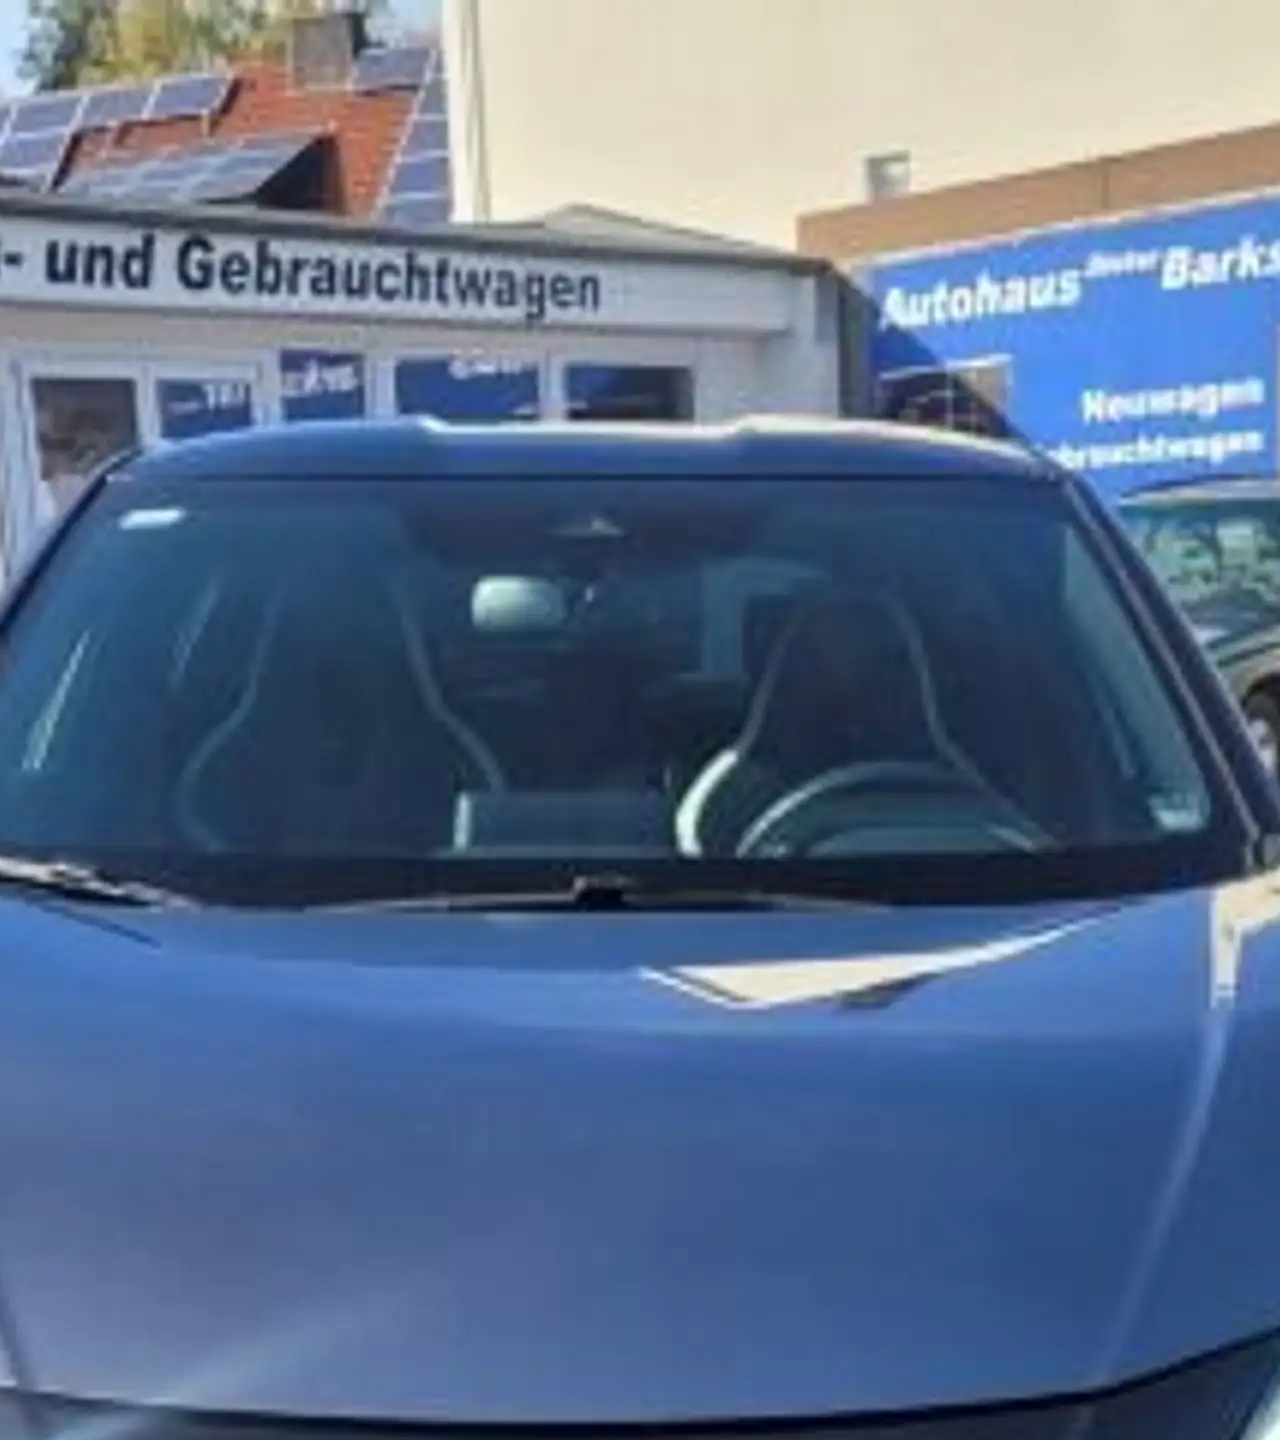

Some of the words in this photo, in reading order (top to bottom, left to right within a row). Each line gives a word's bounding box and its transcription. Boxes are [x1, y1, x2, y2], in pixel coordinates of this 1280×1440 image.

[45, 231, 155, 289] und
[176, 233, 602, 320] Gebrauchtwagen
[878, 268, 1082, 331] Autohaus
[1081, 376, 1265, 424] Neuwagen
[1038, 431, 1264, 471] ebrauchtwagen
